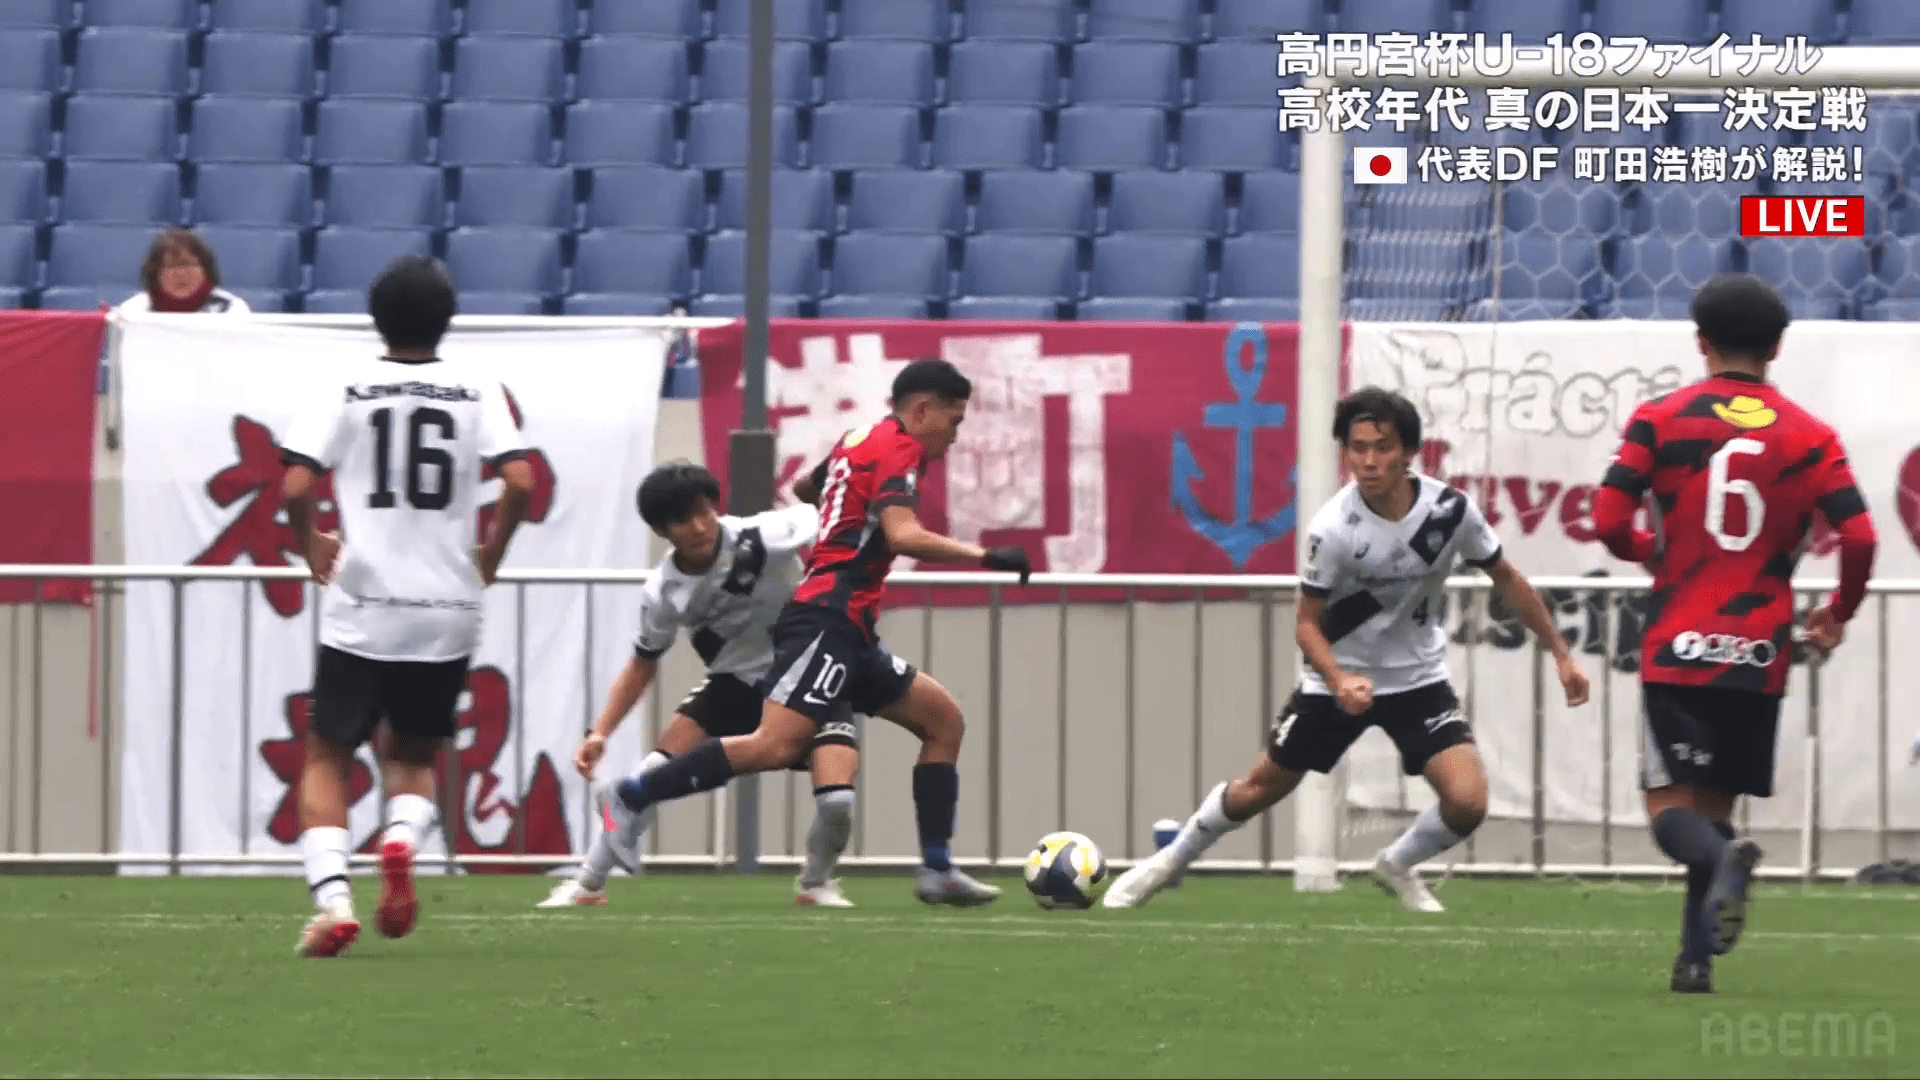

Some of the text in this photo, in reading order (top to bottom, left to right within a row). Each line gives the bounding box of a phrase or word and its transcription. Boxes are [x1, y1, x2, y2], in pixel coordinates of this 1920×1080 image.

[368, 407, 456, 510] 16
[1704, 437, 1767, 551] 6
[812, 652, 847, 698] 10
